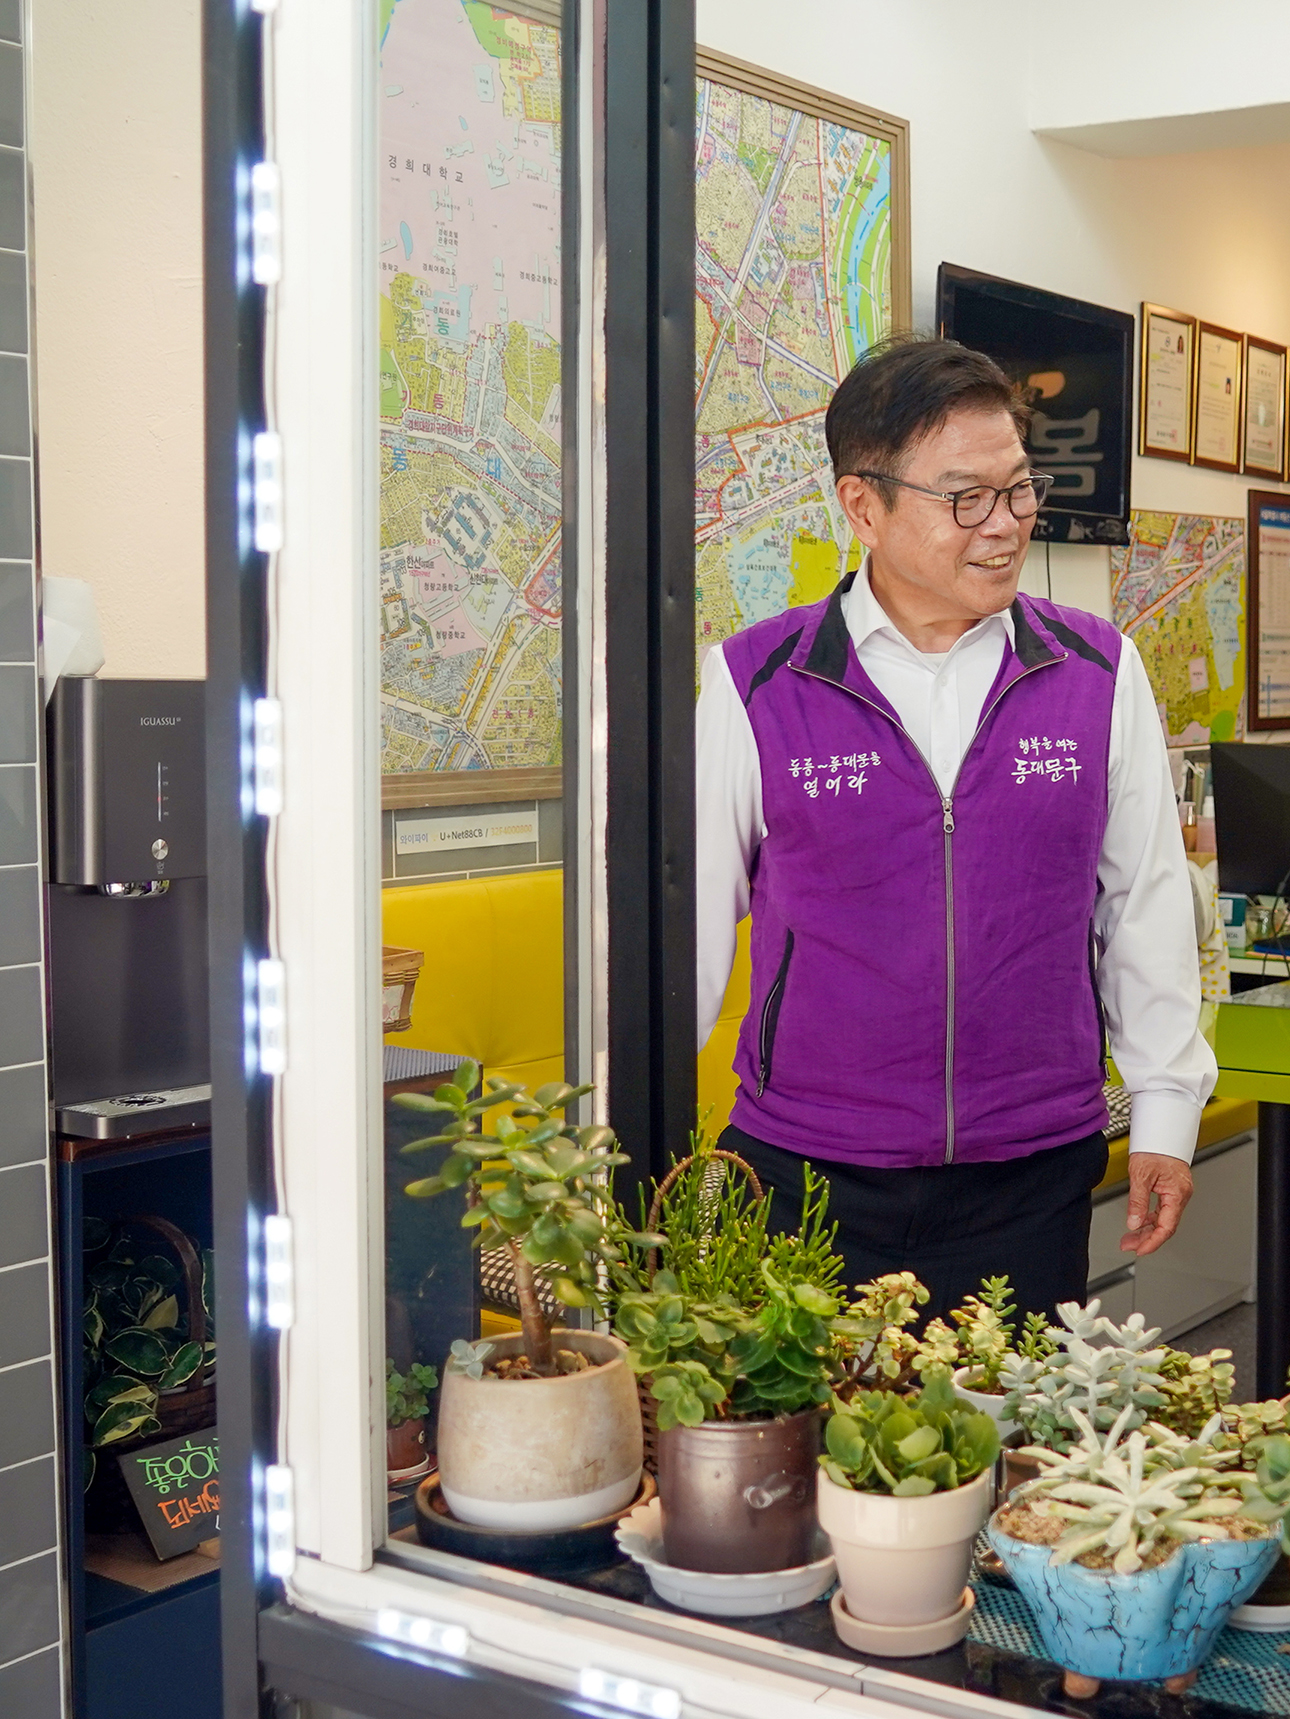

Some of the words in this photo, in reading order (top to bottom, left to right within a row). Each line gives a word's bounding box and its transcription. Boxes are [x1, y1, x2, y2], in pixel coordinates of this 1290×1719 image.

[388, 154, 464, 183] 경희대학교
[379, 262, 399, 273] 등학교
[140, 717, 177, 727] IGUASSU
[1018, 736, 1053, 756] 행복을
[1055, 738, 1078, 752] 여는
[1010, 757, 1083, 785] 동대문구
[803, 770, 869, 798] 열어라
